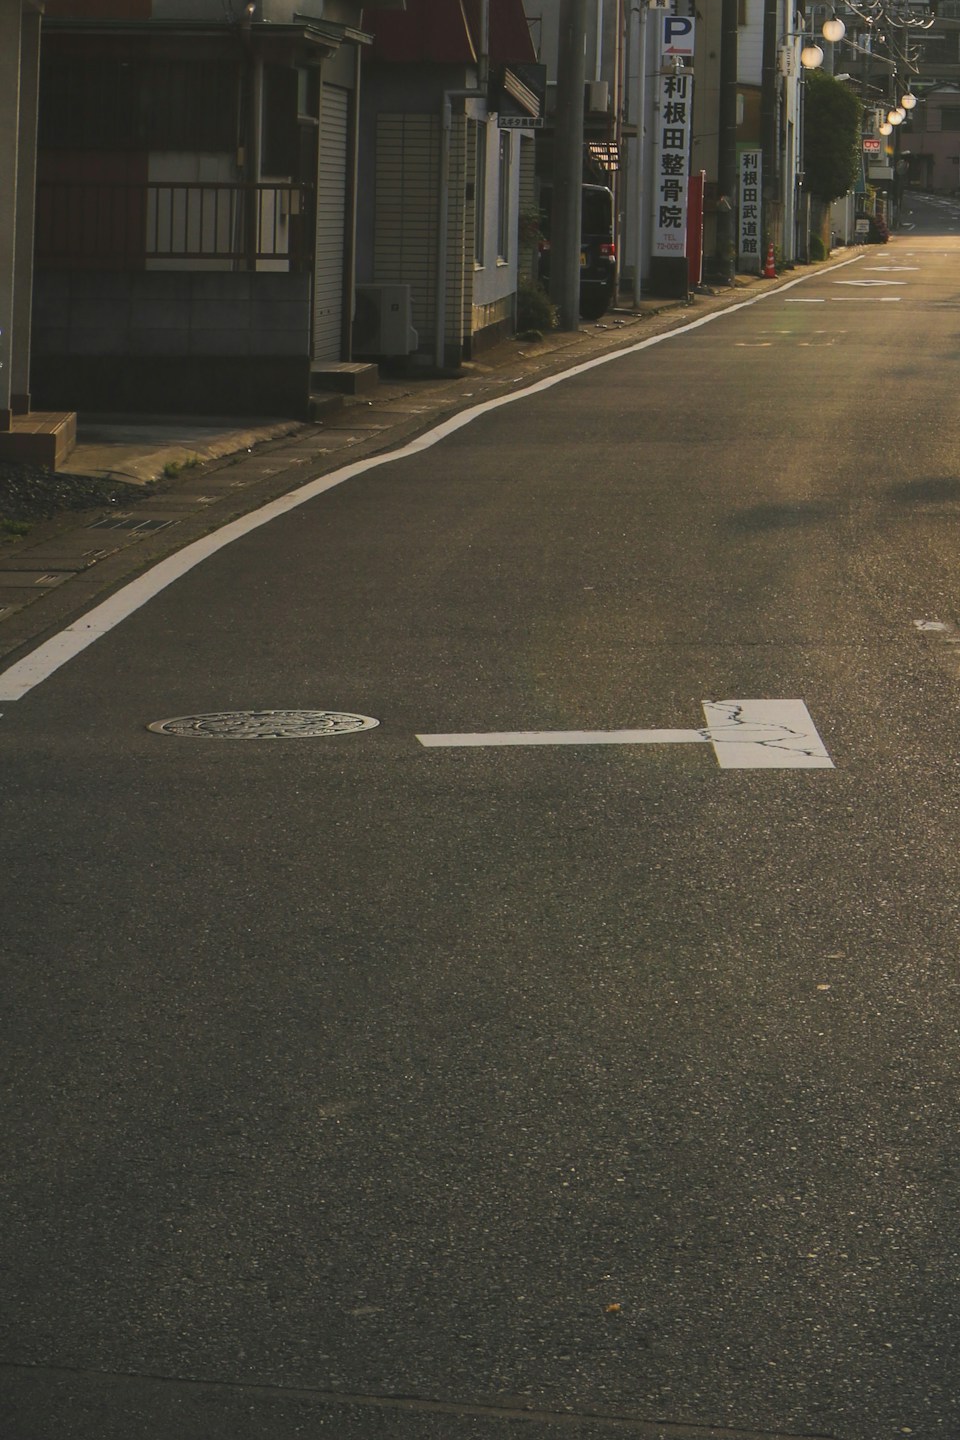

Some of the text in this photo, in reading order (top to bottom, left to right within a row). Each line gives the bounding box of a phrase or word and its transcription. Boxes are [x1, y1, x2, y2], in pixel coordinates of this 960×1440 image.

[664, 17, 692, 44] P
[658, 75, 688, 229] 利根田整骨院
[742, 153, 758, 254] 利根田武道館
